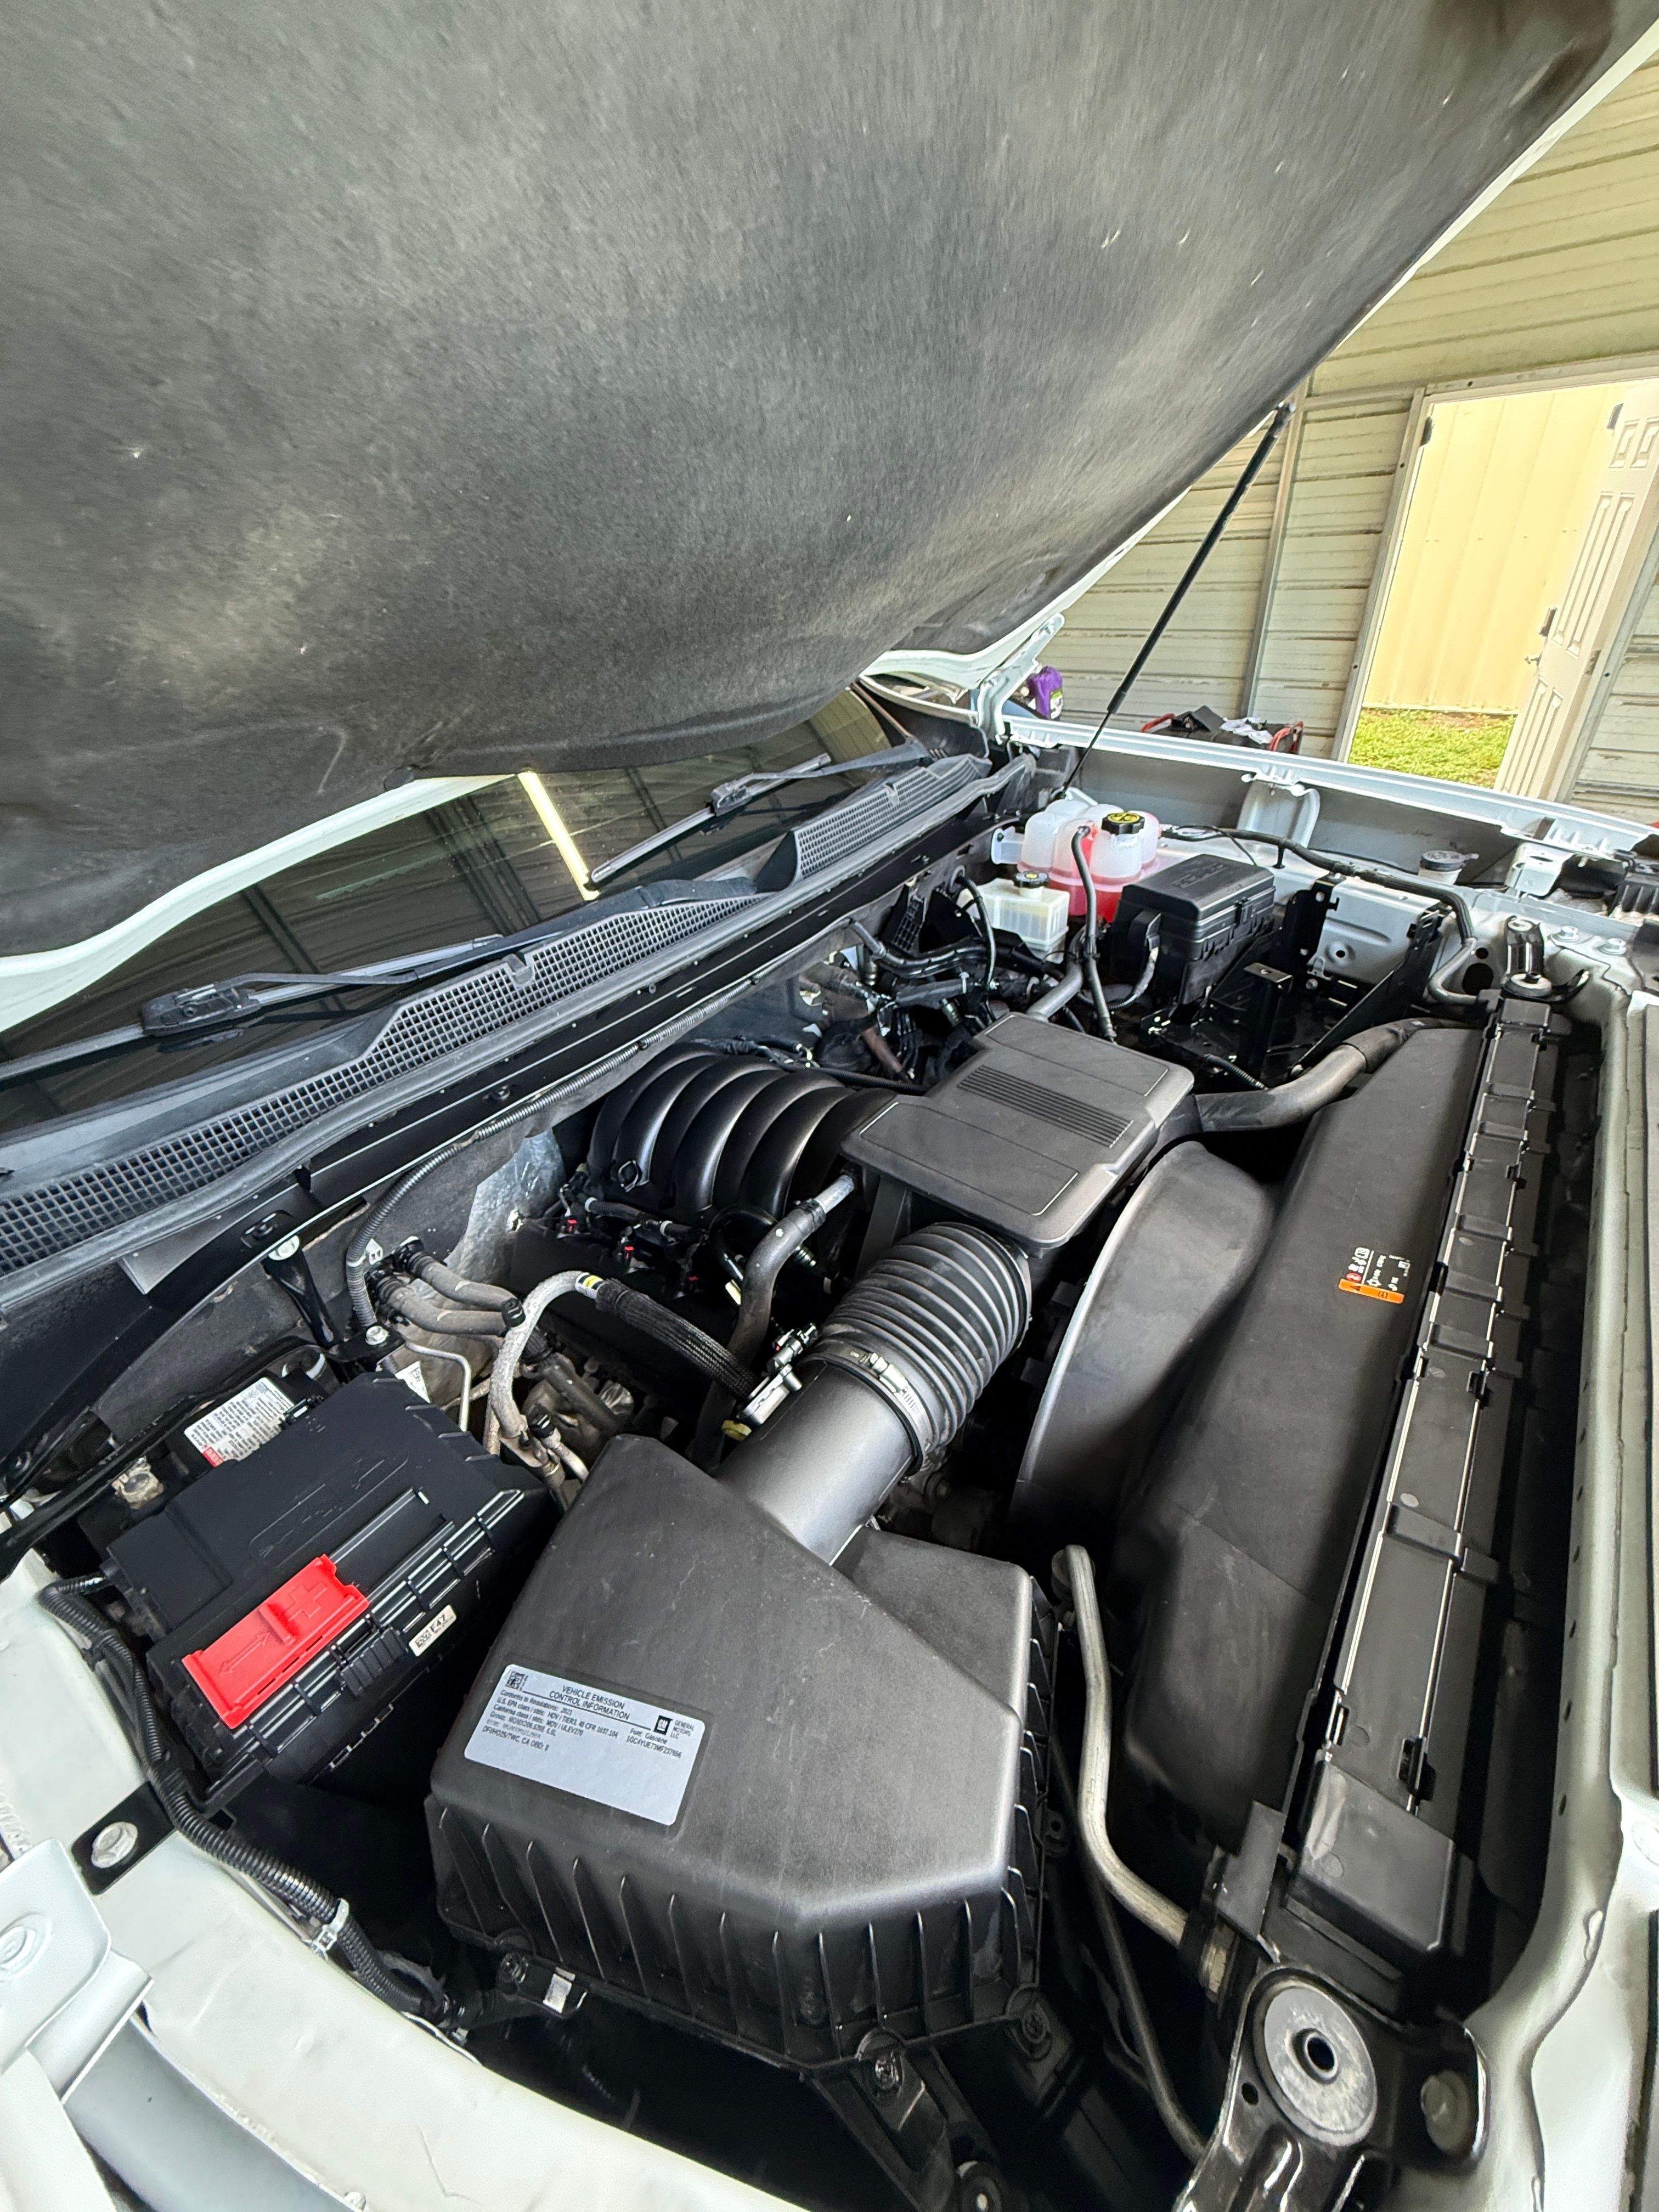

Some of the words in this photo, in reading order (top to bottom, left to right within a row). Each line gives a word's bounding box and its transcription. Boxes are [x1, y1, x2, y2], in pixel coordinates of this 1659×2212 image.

[562, 1685, 591, 1699] VEHICLE
[591, 1694, 624, 1709] EMISSION
[549, 1691, 580, 1706] CONTROL
[583, 1701, 630, 1719] INFORMATION
[585, 1723, 596, 1731] CFR
[673, 1726, 690, 1736] MOTORS
[675, 1720, 693, 1731] GENERAL
[645, 1733, 667, 1744] Gasoline
